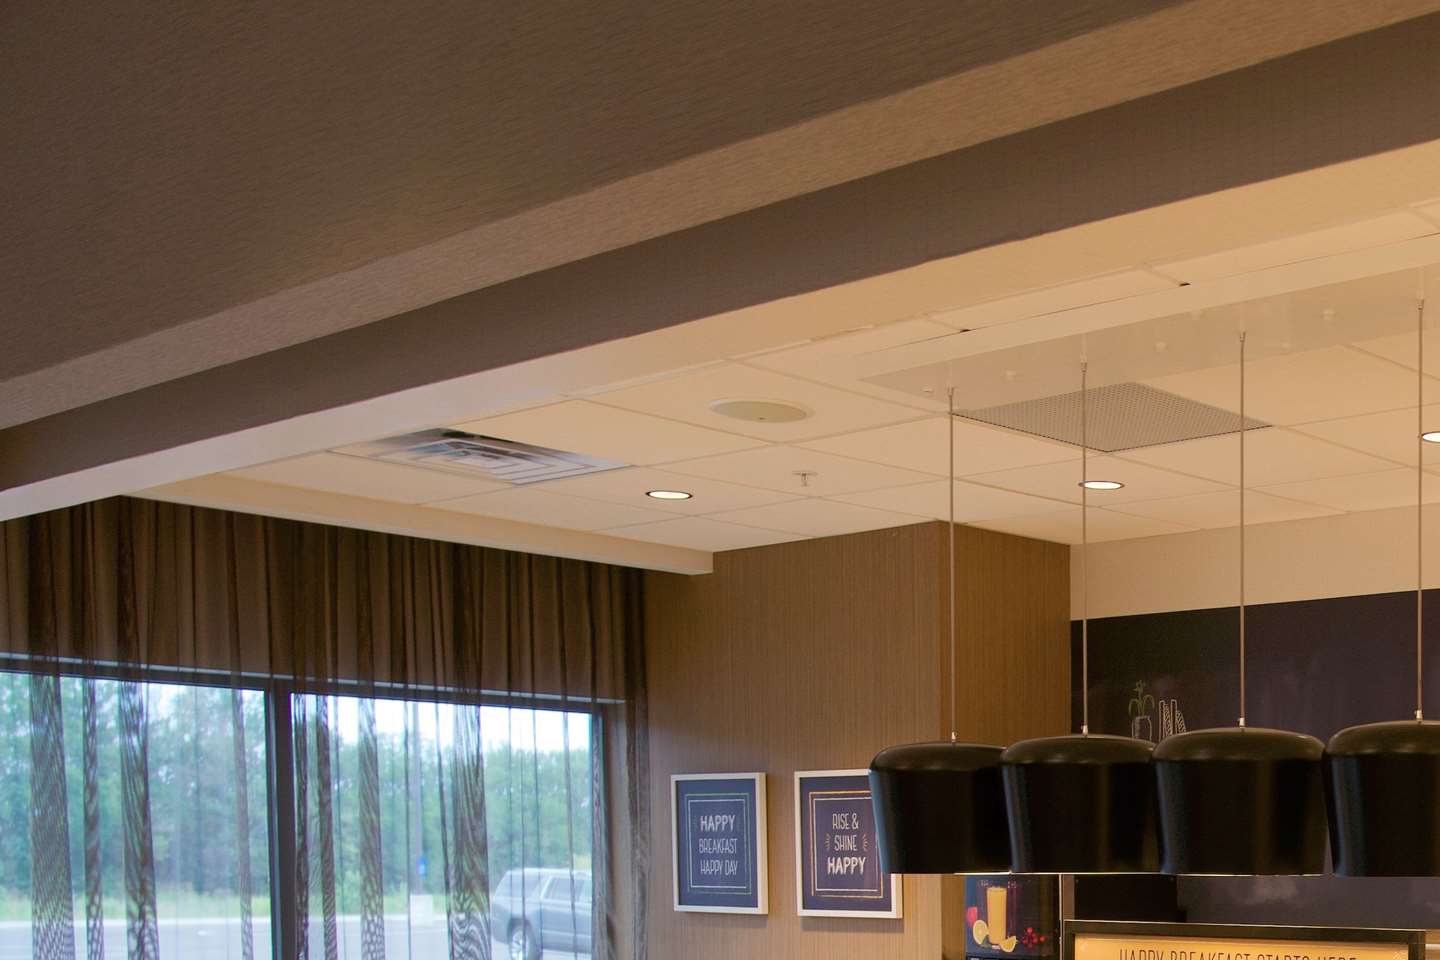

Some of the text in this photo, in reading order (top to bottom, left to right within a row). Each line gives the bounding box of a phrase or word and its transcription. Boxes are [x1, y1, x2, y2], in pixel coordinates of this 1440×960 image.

[700, 815, 736, 832] HAPPY
[832, 813, 859, 830] RISE &
[699, 838, 738, 854] BREAKFAST
[834, 835, 858, 851] SHINE
[700, 859, 738, 875] HAPPY DAY
[827, 857, 866, 875] HAPPY
